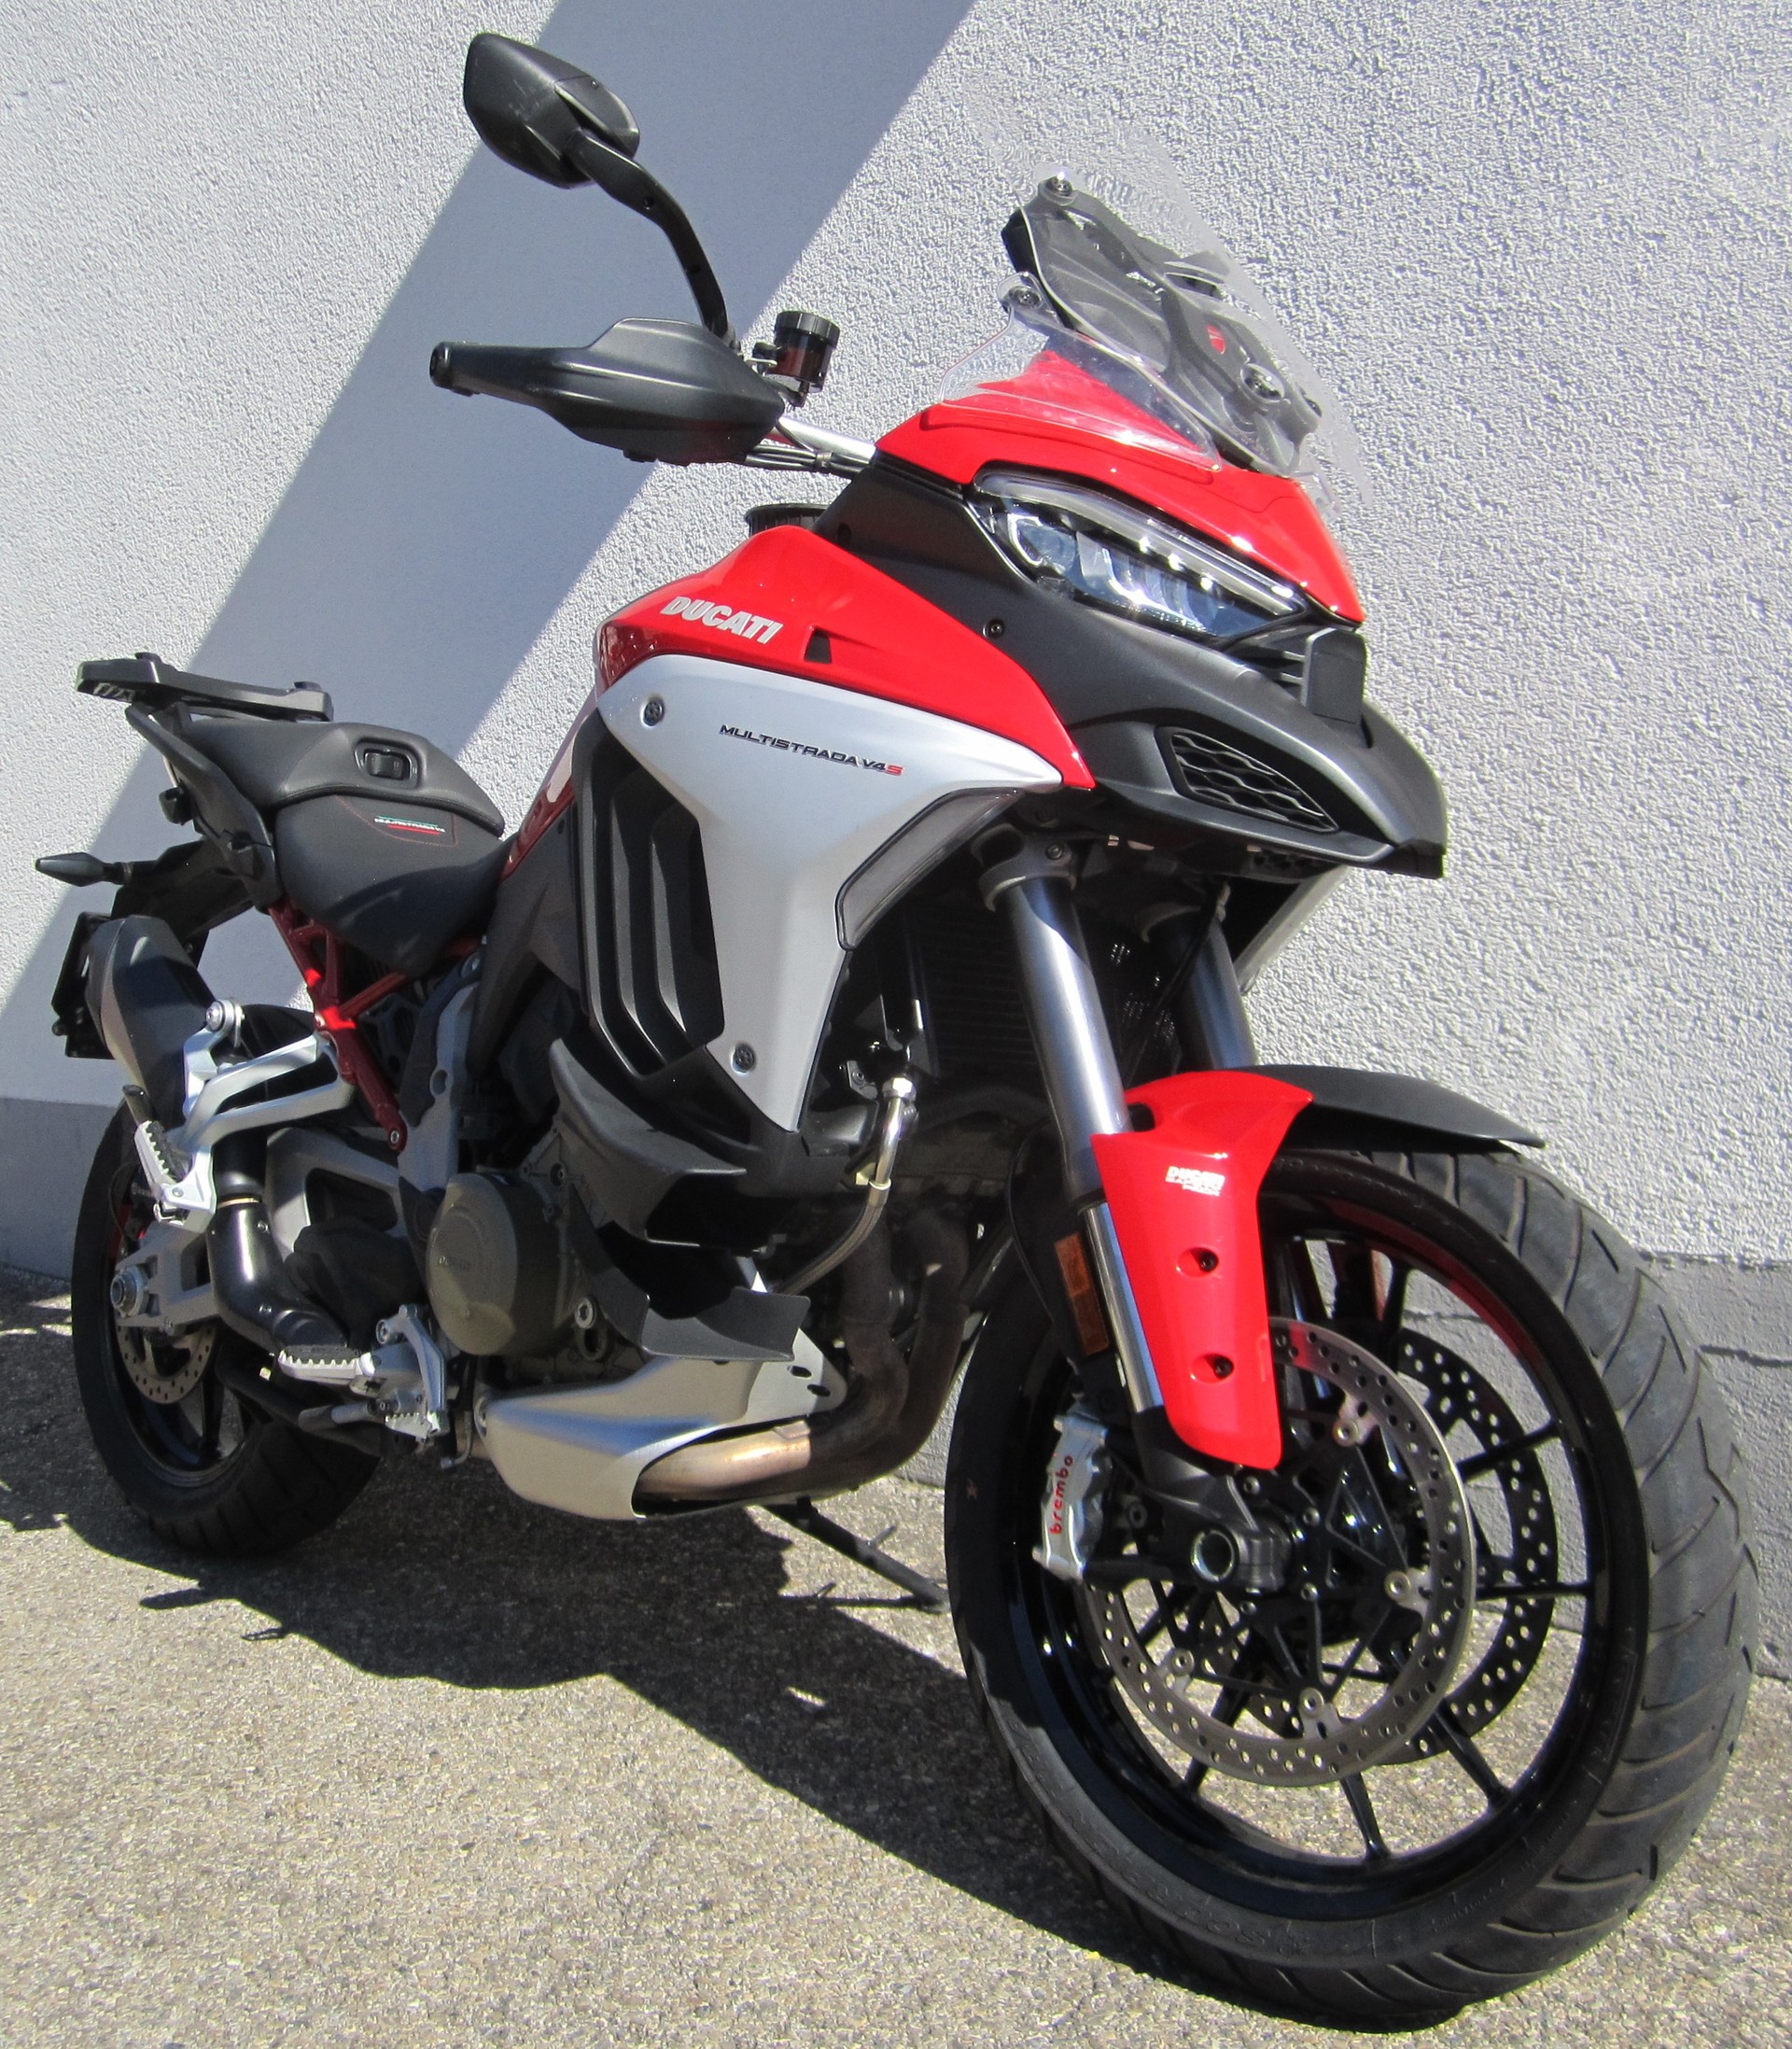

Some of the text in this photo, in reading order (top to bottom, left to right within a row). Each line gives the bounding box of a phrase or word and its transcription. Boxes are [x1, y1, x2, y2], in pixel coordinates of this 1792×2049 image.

[659, 596, 784, 645] DUCATI
[719, 723, 906, 777] MULTISTRADA V4S
[1049, 1454, 1073, 1536] brembo
